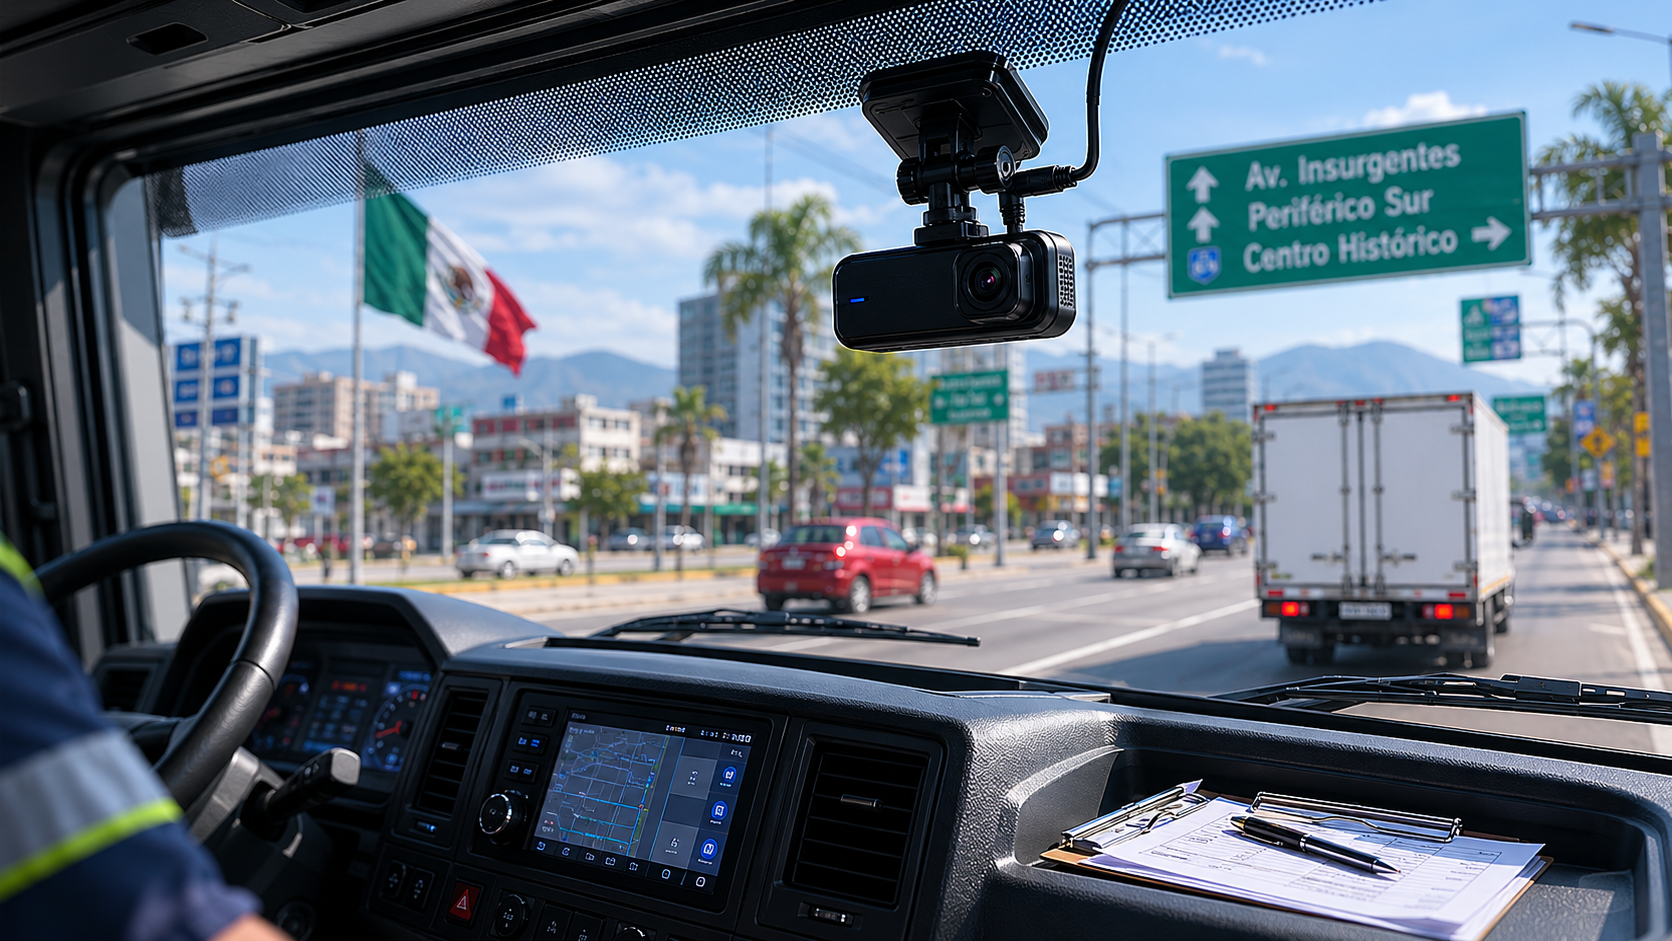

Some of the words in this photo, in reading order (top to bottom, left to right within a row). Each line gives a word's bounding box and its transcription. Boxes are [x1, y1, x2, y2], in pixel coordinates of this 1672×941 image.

[1245, 160, 1288, 191] Av.
[1298, 142, 1461, 185] Insurgentes
[1248, 193, 1376, 231] Periférico
[1384, 186, 1434, 218] Sur
[1243, 239, 1330, 273] Centro
[1338, 226, 1459, 264] Histórico
